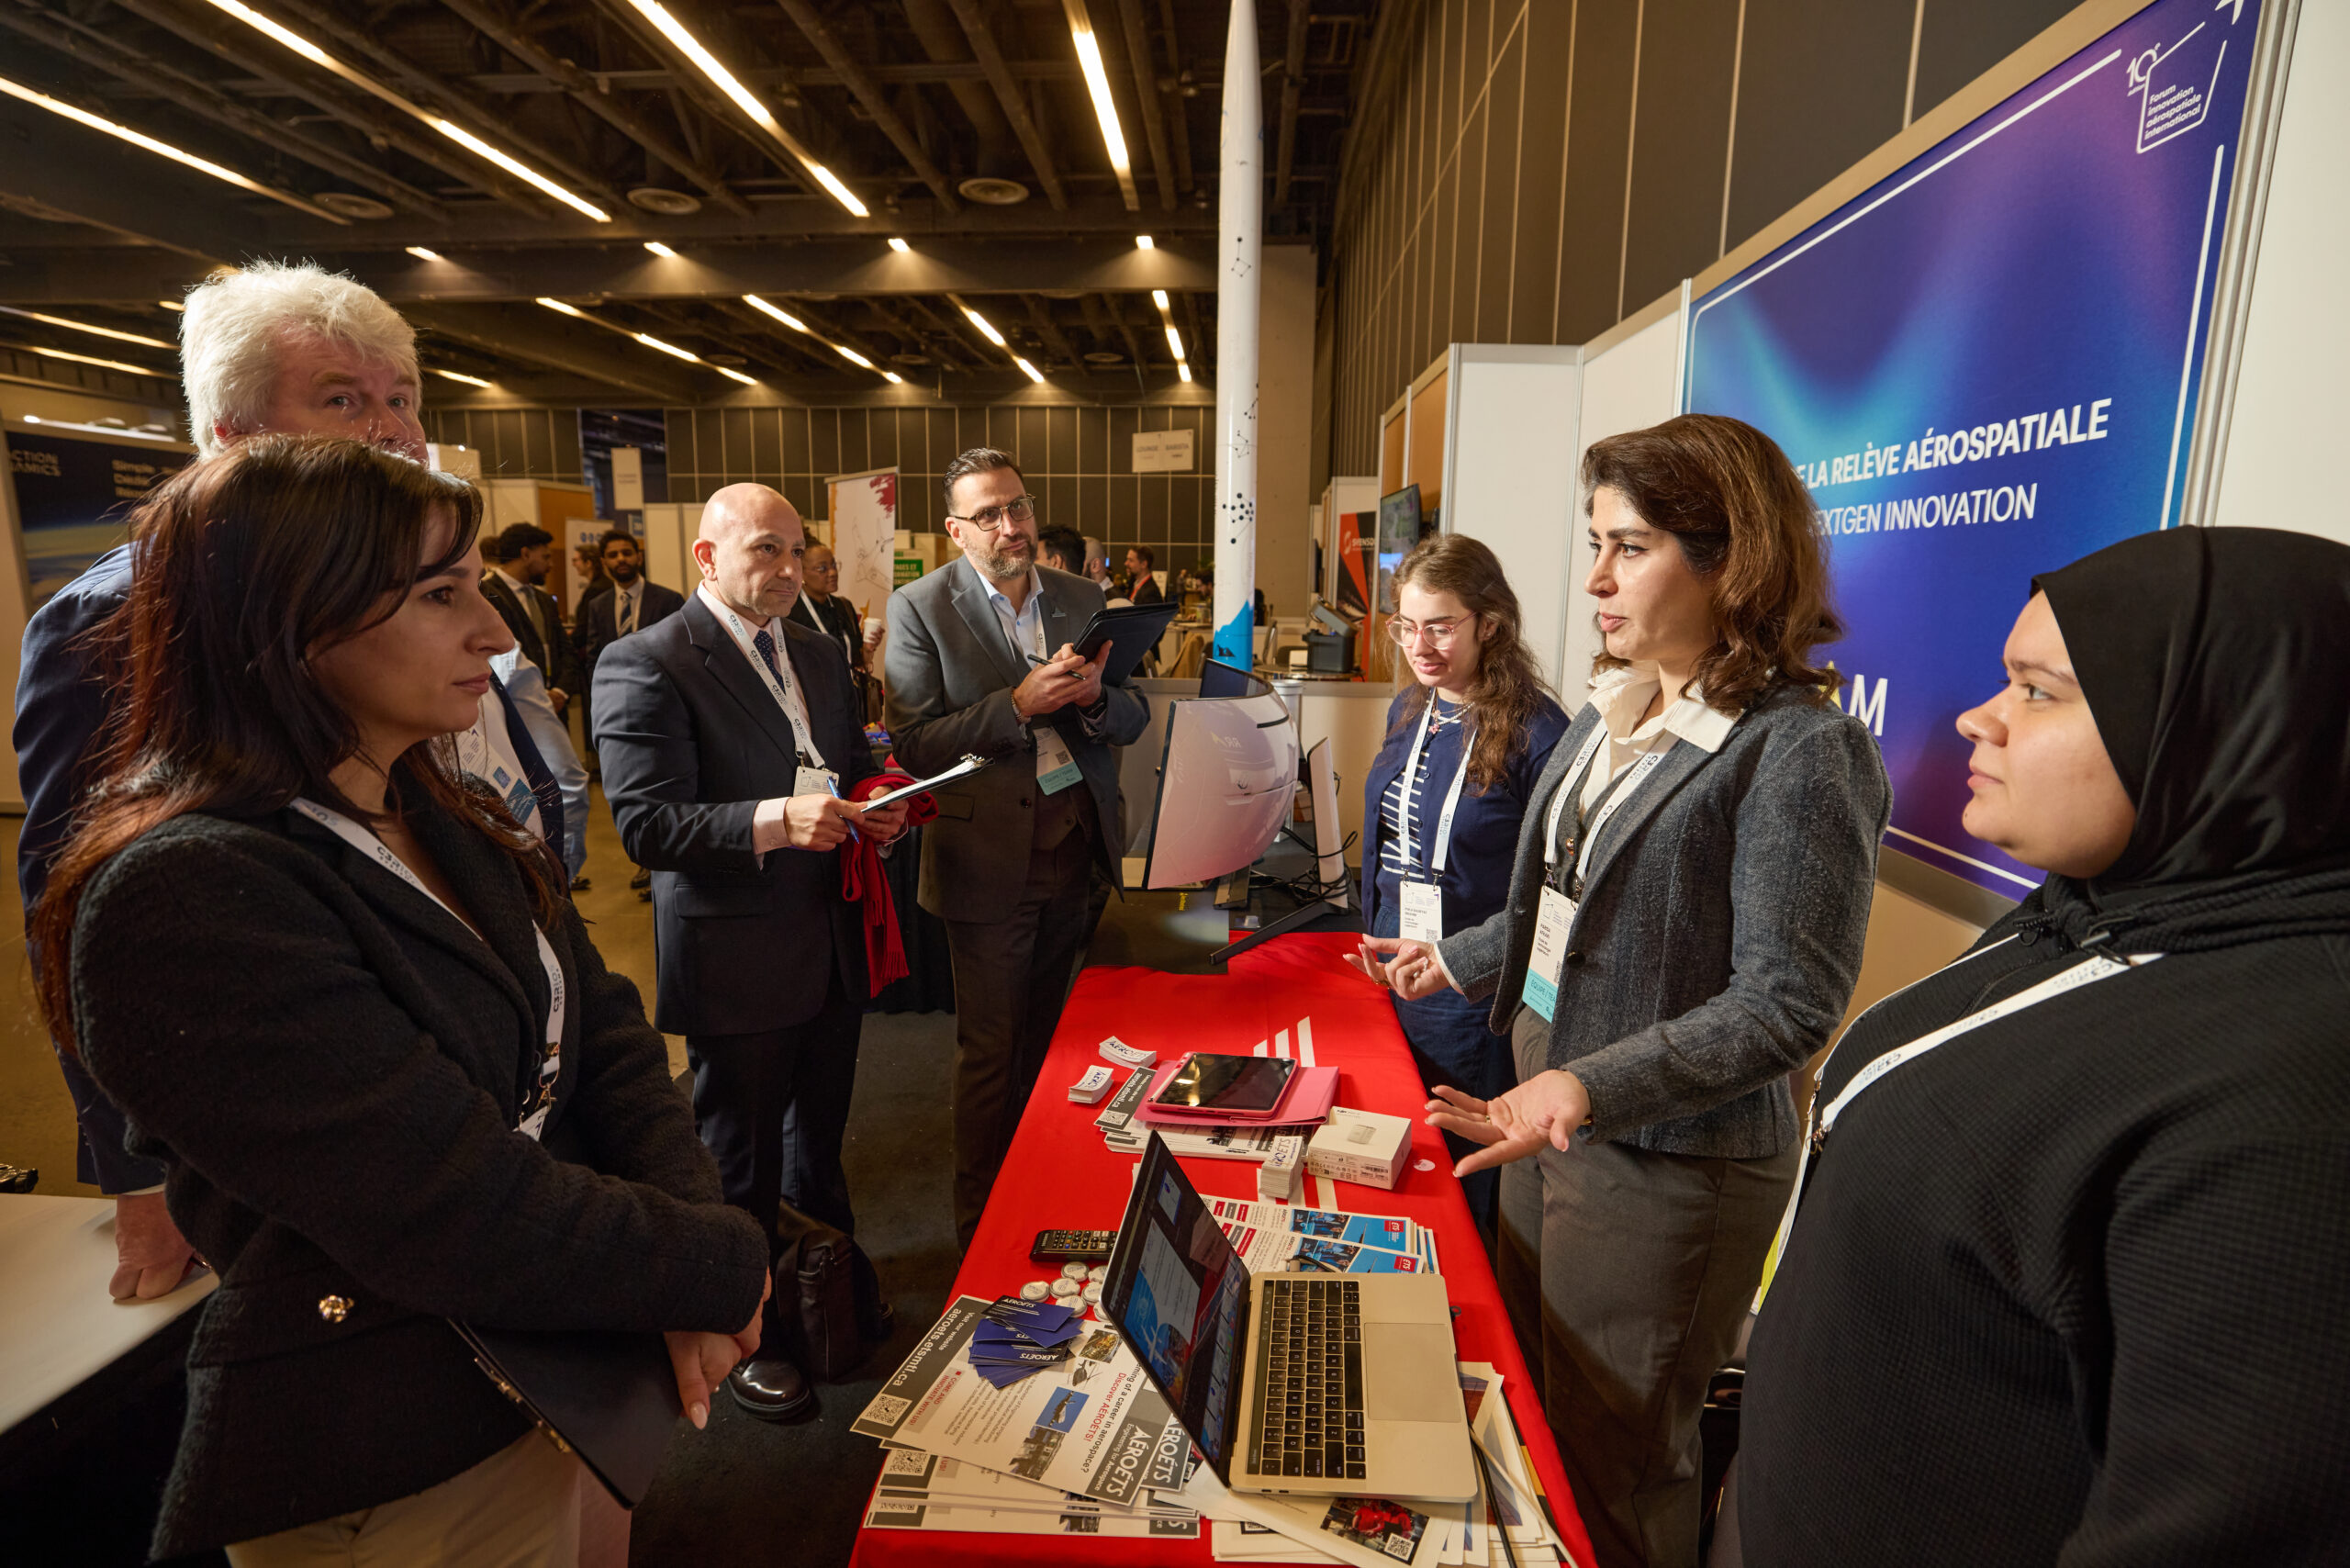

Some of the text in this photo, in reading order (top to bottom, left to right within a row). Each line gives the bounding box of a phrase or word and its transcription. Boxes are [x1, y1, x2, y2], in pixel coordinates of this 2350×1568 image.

[2147, 86, 2194, 117] innovation
[2149, 84, 2176, 105] Forum
[2144, 103, 2200, 140] international
[2145, 94, 2201, 129] aérospatiale
[1807, 460, 1829, 489] LA
[1831, 442, 1901, 486] RELÈVE
[1902, 398, 2111, 473] AÉROSPATIALE
[1885, 483, 2038, 531] INNOVATION
[892, 1308, 962, 1387] aeroets.etsmtl.ca
[938, 1312, 975, 1350] Visit our website
[926, 1375, 949, 1402] INNOVATE
[934, 1377, 957, 1406] COME AND
[1125, 1383, 1132, 1392] of
[920, 1401, 931, 1416] WITH
[1083, 1372, 1127, 1442] Discover AÉROÉTS!
[1111, 1397, 1125, 1419] career
[1104, 1420, 1112, 1428] in
[1114, 1423, 1135, 1456] Engineering
[1082, 1428, 1108, 1473] aerospace?
[1106, 1426, 1153, 1497] AÉROÉTS
[1094, 1460, 1114, 1492] Aerospace
